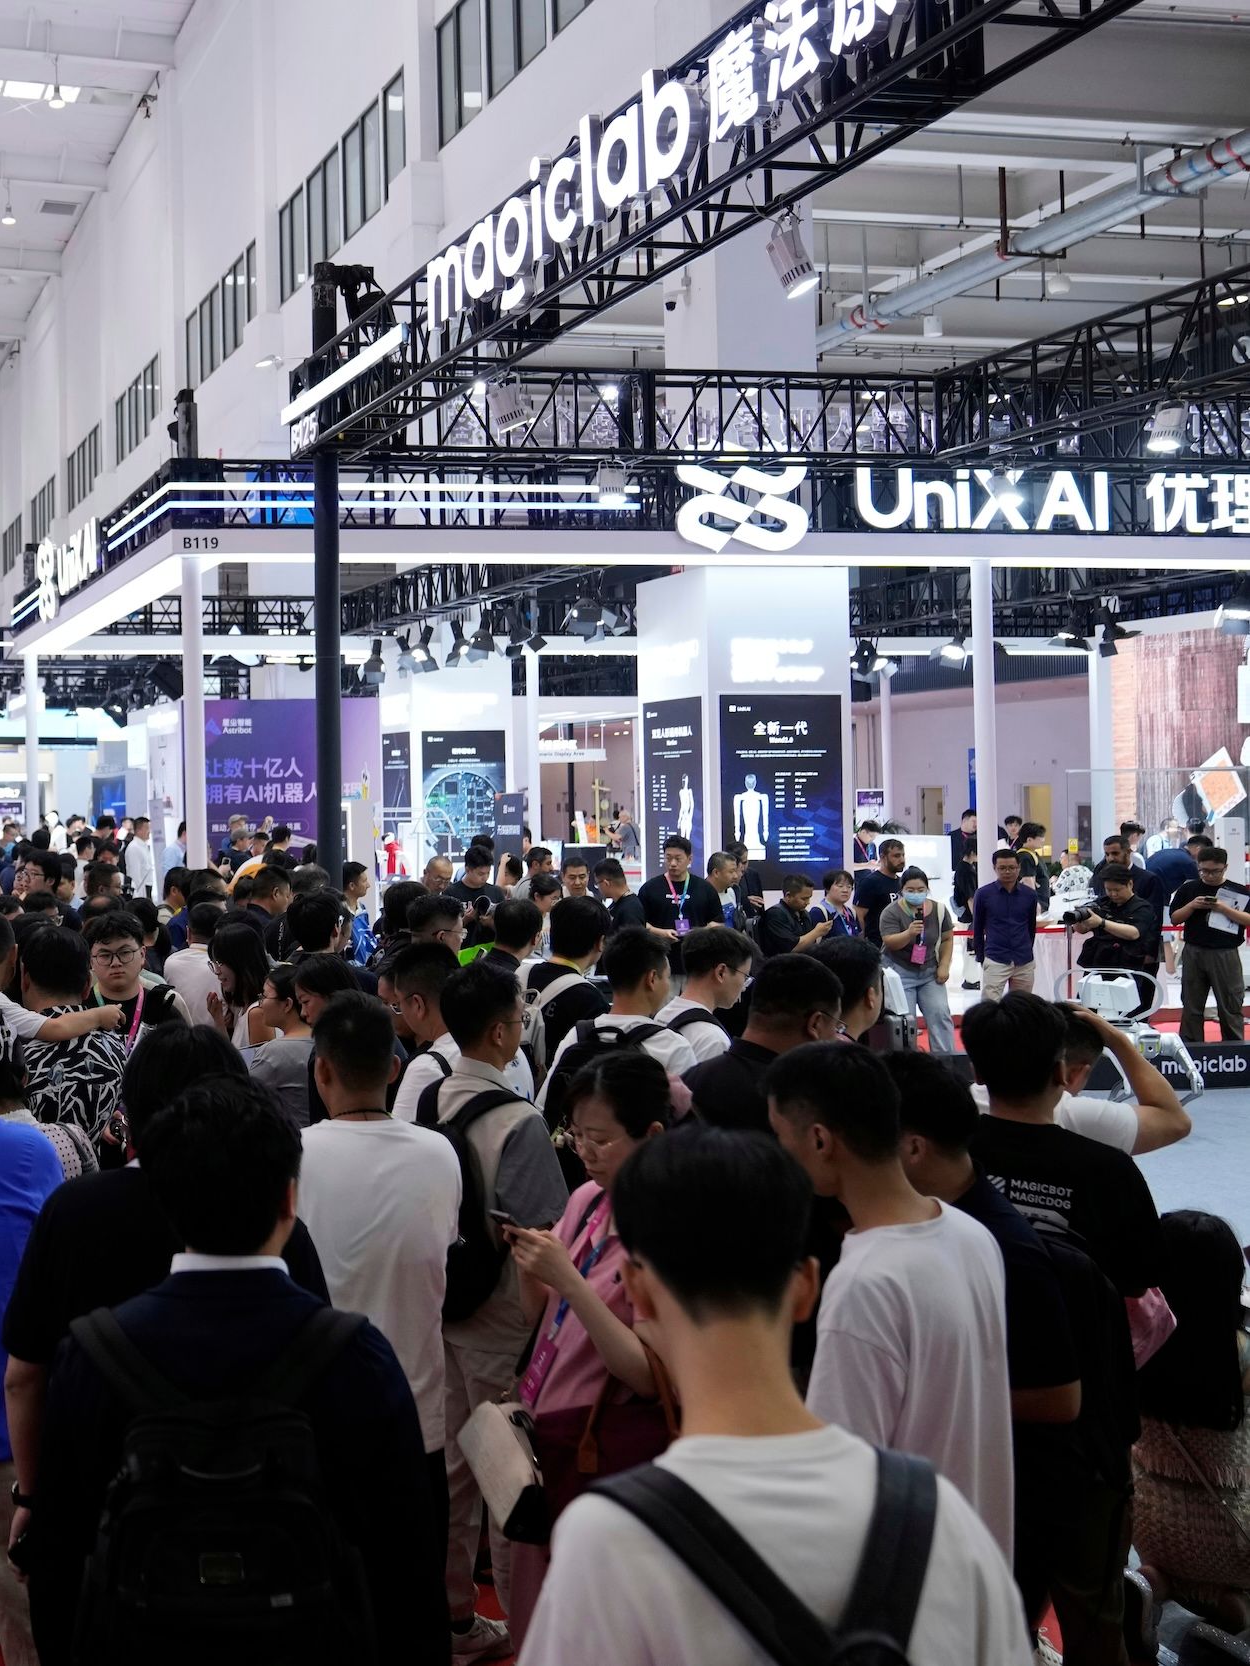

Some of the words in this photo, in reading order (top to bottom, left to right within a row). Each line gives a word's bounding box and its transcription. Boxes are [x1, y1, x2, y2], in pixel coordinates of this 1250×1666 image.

[426, 67, 692, 332] magiclab
[183, 537, 219, 549] B119
[222, 726, 252, 734] Astribot
[753, 720, 809, 736] 全新一代
[206, 757, 303, 779] 让数十亿人
[1010, 1178, 1074, 1198] MAGICBOT
[1009, 1190, 1072, 1210] MAGICDOG
